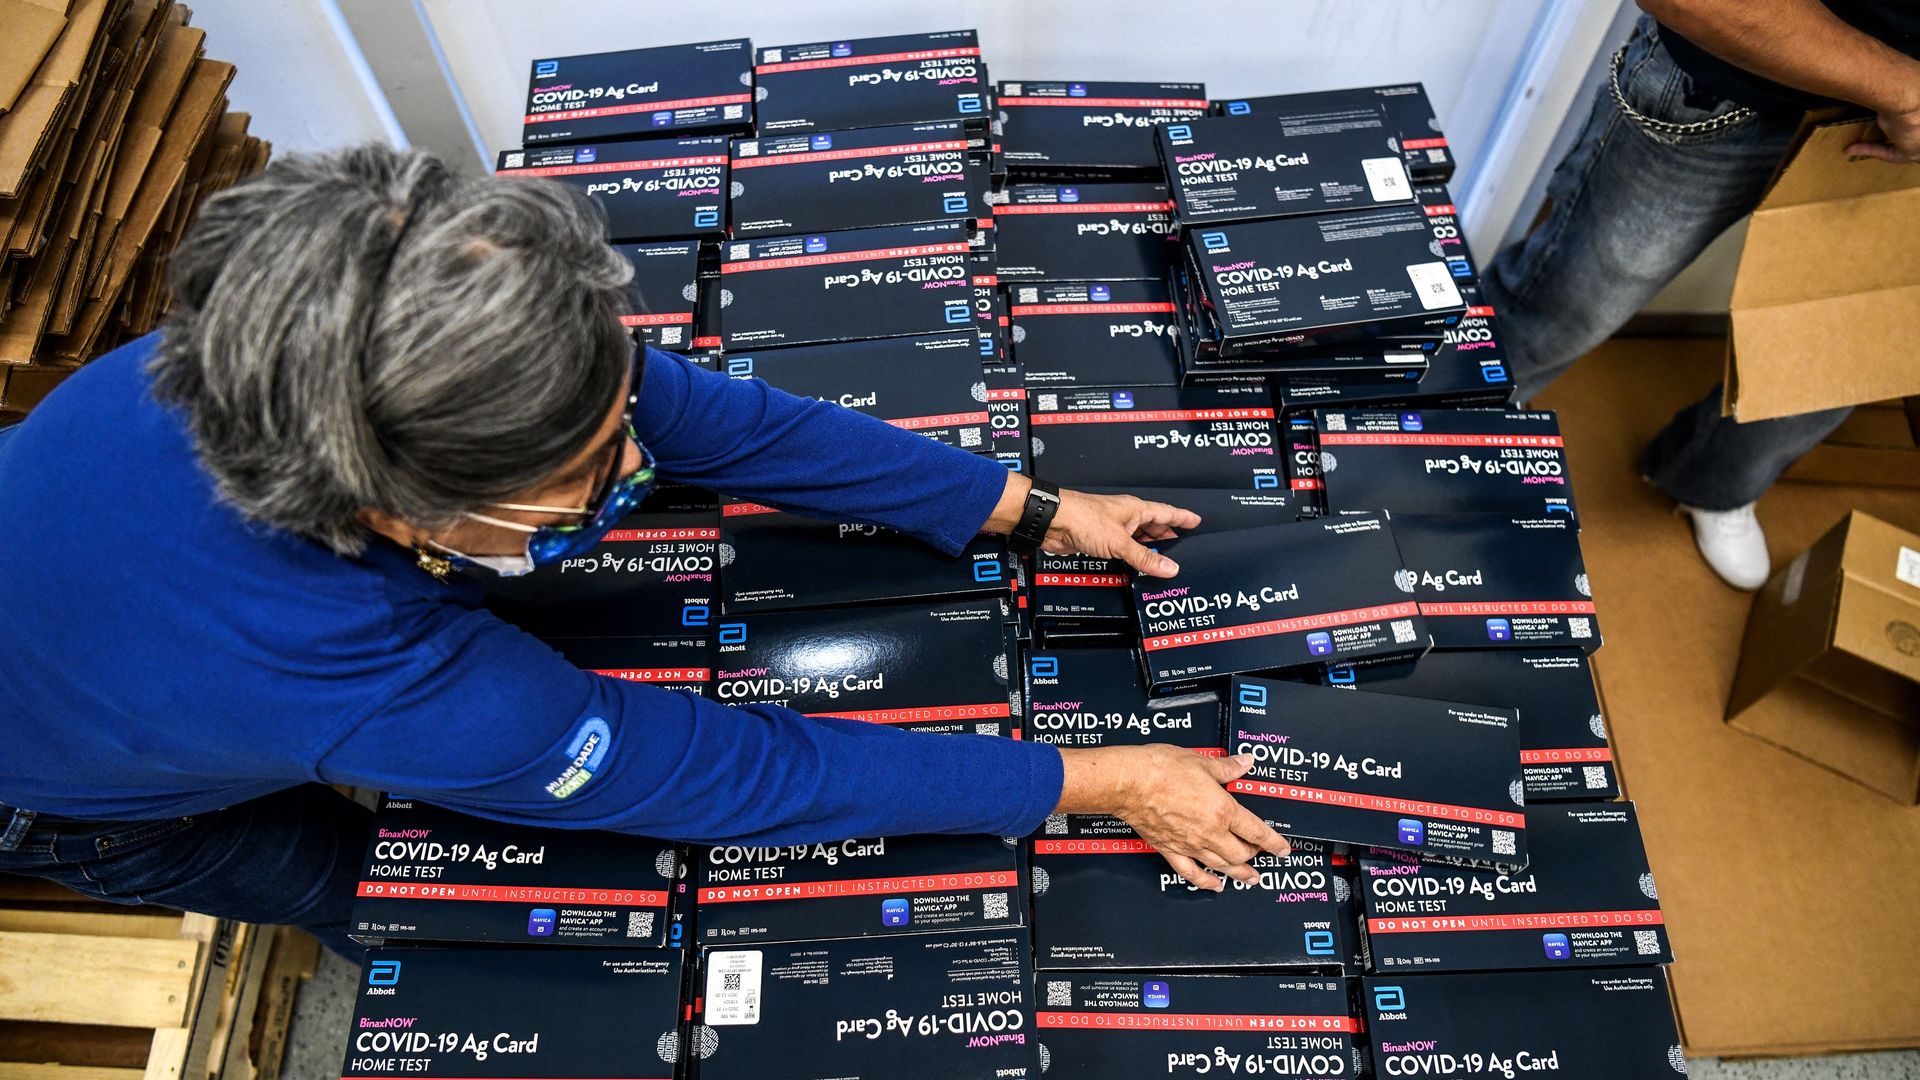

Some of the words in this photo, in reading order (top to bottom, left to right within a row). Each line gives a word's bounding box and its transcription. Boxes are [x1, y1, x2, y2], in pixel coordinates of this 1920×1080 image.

[904, 155, 927, 163] TEST
[929, 152, 961, 161] HOME
[864, 164, 885, 178] Ag
[888, 162, 963, 180] COVID-19
[1176, 157, 1252, 175] COVID-19
[1255, 157, 1276, 171] Ag
[1276, 153, 1308, 166] Card
[830, 170, 862, 182] Card
[1181, 175, 1213, 185] HOME
[1214, 173, 1237, 182] TEST
[1078, 224, 1109, 235] Card
[1110, 220, 1130, 234] Ag
[904, 258, 928, 267] TEST
[930, 256, 963, 264] HOME
[862, 269, 883, 284] Ag
[886, 266, 966, 286] COVID-19
[1216, 266, 1293, 286] COVID-19
[1297, 264, 1319, 279] Ag
[1318, 259, 1352, 273] Card
[825, 275, 859, 289] Card
[1220, 285, 1254, 296] HOME
[1255, 282, 1279, 292] TEST
[1110, 325, 1142, 337] Card
[1144, 320, 1164, 336] Ag
[840, 392, 876, 408] Card
[1211, 422, 1234, 430] TEST
[1236, 422, 1269, 430] HOME
[1134, 435, 1168, 448] Card
[1170, 430, 1191, 447] Ag
[1194, 433, 1271, 447] COVID-19
[1501, 449, 1524, 458] TEST
[1526, 450, 1558, 458] HOME
[1425, 460, 1459, 473] Card
[1460, 455, 1481, 473] Ag
[1485, 460, 1561, 475] COVID-19
[649, 544, 674, 553] TEST
[678, 544, 714, 552] HOME
[562, 559, 598, 572] Card
[602, 553, 624, 572] Ag
[628, 557, 712, 572] COVID-19
[1044, 561, 1078, 569] HOME
[1082, 561, 1108, 570] TEST
[1422, 571, 1444, 591] Ag
[1446, 570, 1482, 585] Card
[1145, 593, 1231, 618] COVID-19
[1236, 591, 1260, 610] Ag
[1261, 584, 1298, 602] Card
[1149, 619, 1186, 632] HOME
[1188, 615, 1215, 627] TEST
[717, 679, 810, 699] COVID-19
[814, 676, 840, 698] Ag
[843, 673, 882, 690] Card
[1240, 706, 1266, 714] Abbott
[1034, 713, 1122, 729] COVID-19
[1127, 713, 1150, 734] Ag
[1153, 712, 1191, 728] Card
[1034, 734, 1072, 744] HOME
[1075, 734, 1102, 744] TEST
[1237, 743, 1330, 769] COVID-19
[1334, 758, 1359, 779] Ag
[1362, 758, 1401, 778] Card
[1280, 769, 1308, 782] TEST
[1236, 782, 1252, 790] DO
[1260, 785, 1284, 794] NOT
[1290, 789, 1322, 799] OPEN
[1330, 794, 1364, 805] UNTIL
[1371, 798, 1448, 816] INSTRUCTED
[1454, 809, 1468, 818] TO
[1476, 812, 1492, 820] DO
[1499, 814, 1514, 823] SO
[1427, 822, 1464, 832] DOWNLOAD
[1465, 826, 1480, 834] THE
[842, 838, 884, 856] Card
[376, 842, 469, 862] COVID-19
[472, 848, 496, 869] Ag
[502, 846, 544, 864] Card
[370, 865, 411, 876] HOME
[415, 866, 444, 878] TEST
[709, 869, 750, 881] HOME
[754, 867, 784, 879] TEST
[1373, 877, 1464, 896] COVID-19
[1470, 876, 1494, 900] Ag
[1496, 875, 1536, 893] Card
[1376, 901, 1416, 912] HOME
[1418, 900, 1446, 911] TEST
[942, 994, 974, 1008] TEST
[978, 991, 1021, 1005] HOME
[837, 1019, 882, 1040] Card
[886, 1010, 913, 1036] Ag
[919, 1010, 1023, 1035] COVID-19
[357, 1032, 458, 1052] COVID-19
[461, 1033, 488, 1060] Ag
[494, 1033, 538, 1053] Card
[1267, 1037, 1297, 1048] TEST
[1301, 1038, 1342, 1049] HOME
[352, 1058, 395, 1070] HOME
[400, 1059, 431, 1071] TEST
[1168, 1054, 1210, 1073] Card
[1214, 1047, 1240, 1073] Ag
[1246, 1055, 1344, 1074] COVID-19
[1386, 1054, 1482, 1075] COVID-19
[1488, 1053, 1514, 1079] Ag
[1516, 1050, 1558, 1070] Card
[996, 1068, 1026, 1077] Abbott
